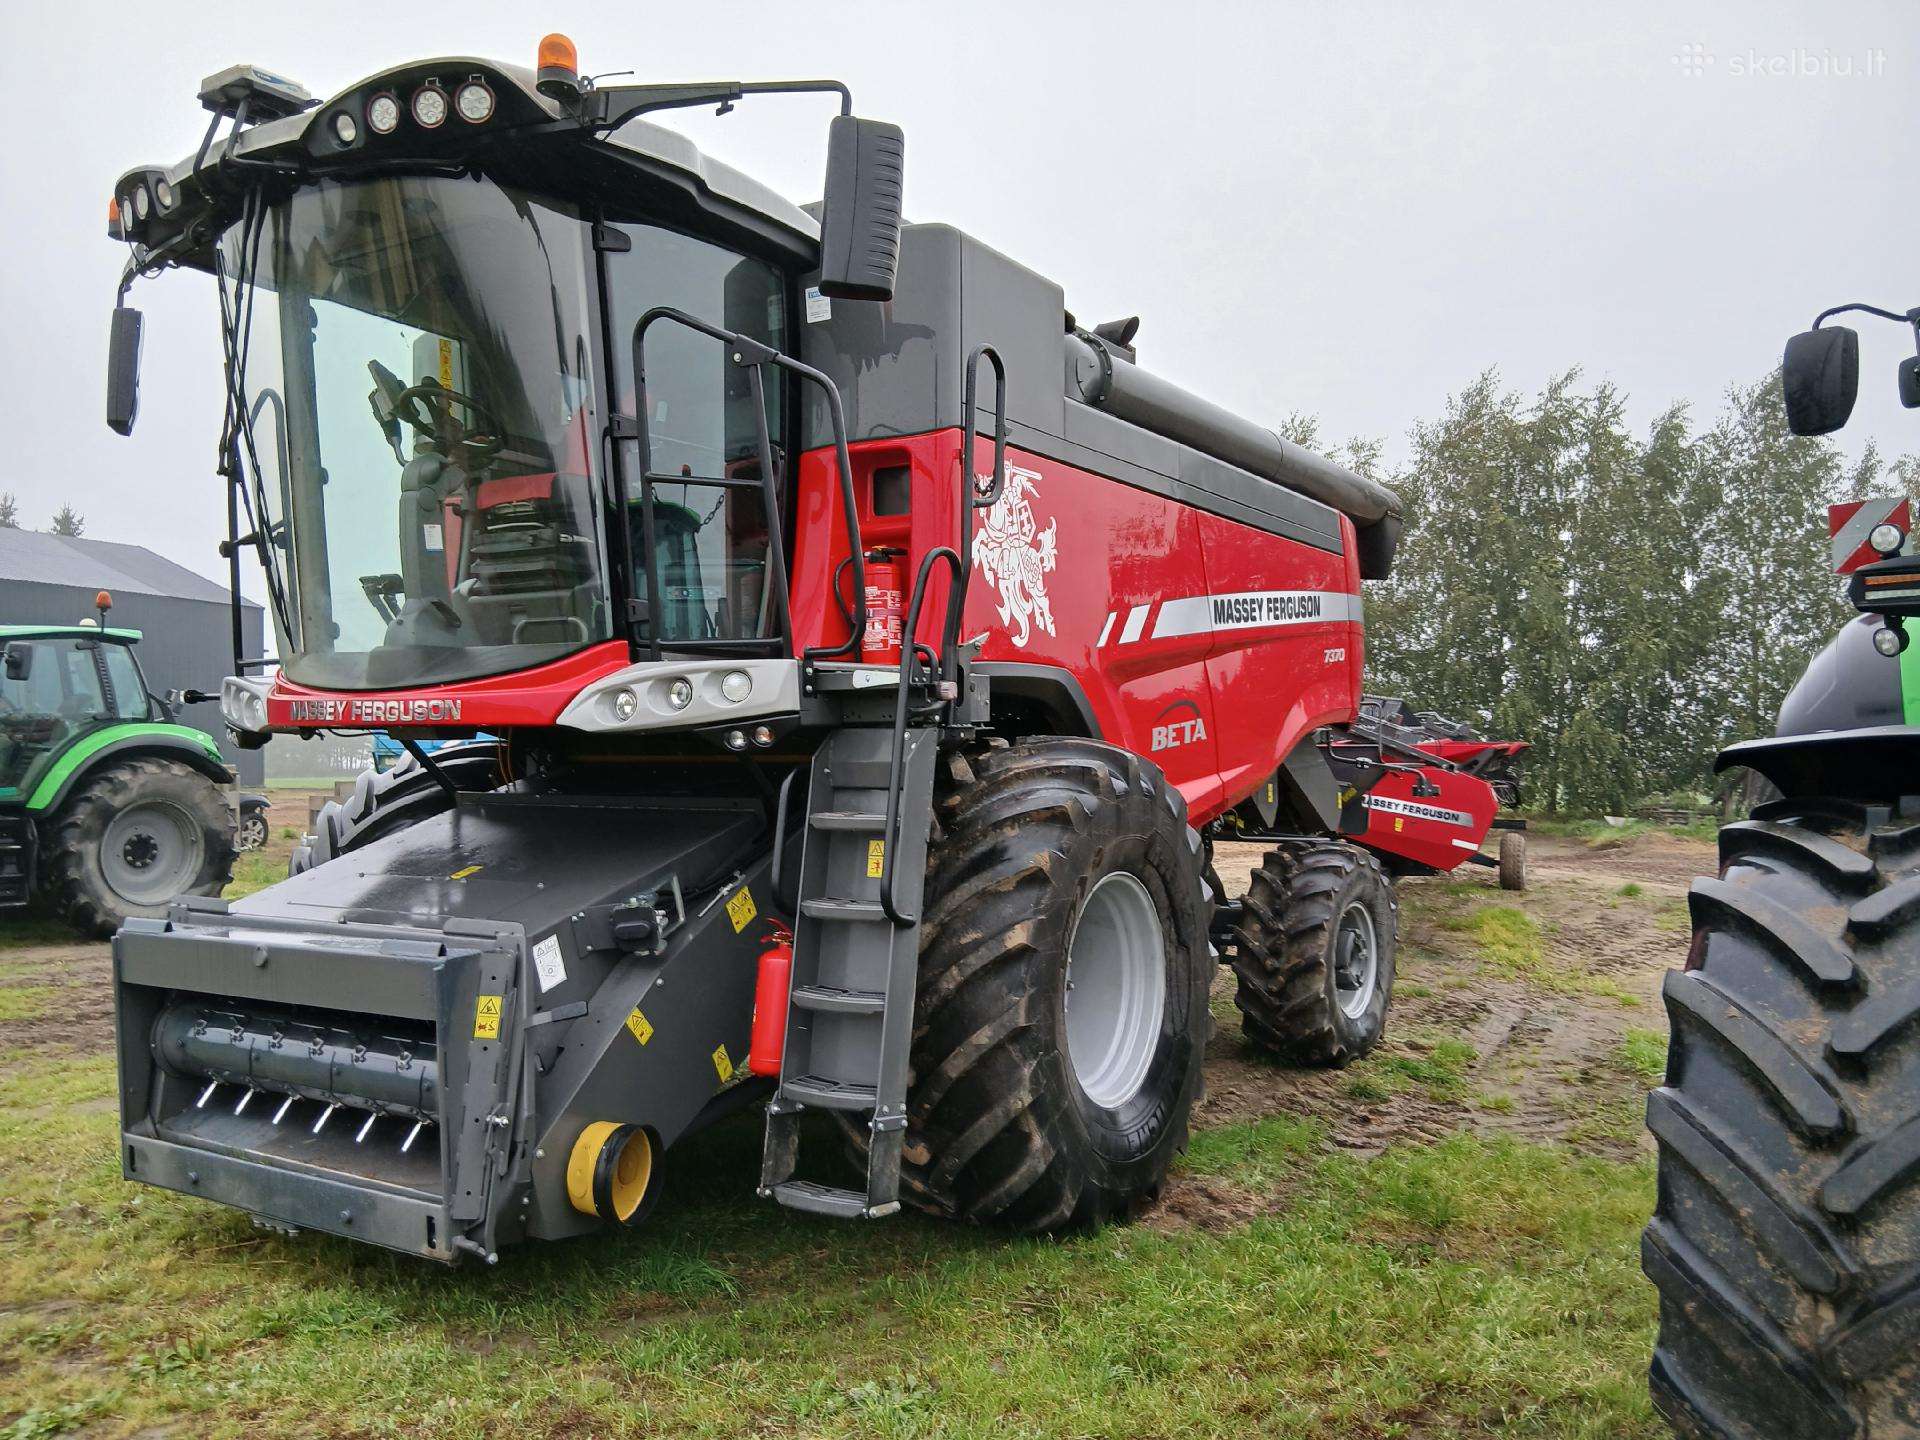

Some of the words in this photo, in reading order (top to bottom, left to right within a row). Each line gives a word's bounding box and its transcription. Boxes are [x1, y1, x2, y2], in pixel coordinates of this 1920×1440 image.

[1214, 597, 1264, 625] MASSEY
[1267, 595, 1321, 622] FERGUSON
[1323, 648, 1346, 664] 7370
[290, 700, 348, 721] MASSEY
[352, 699, 462, 722] FERGUSON
[1151, 718, 1208, 752] BETA
[1402, 803, 1460, 822] FERGUSON
